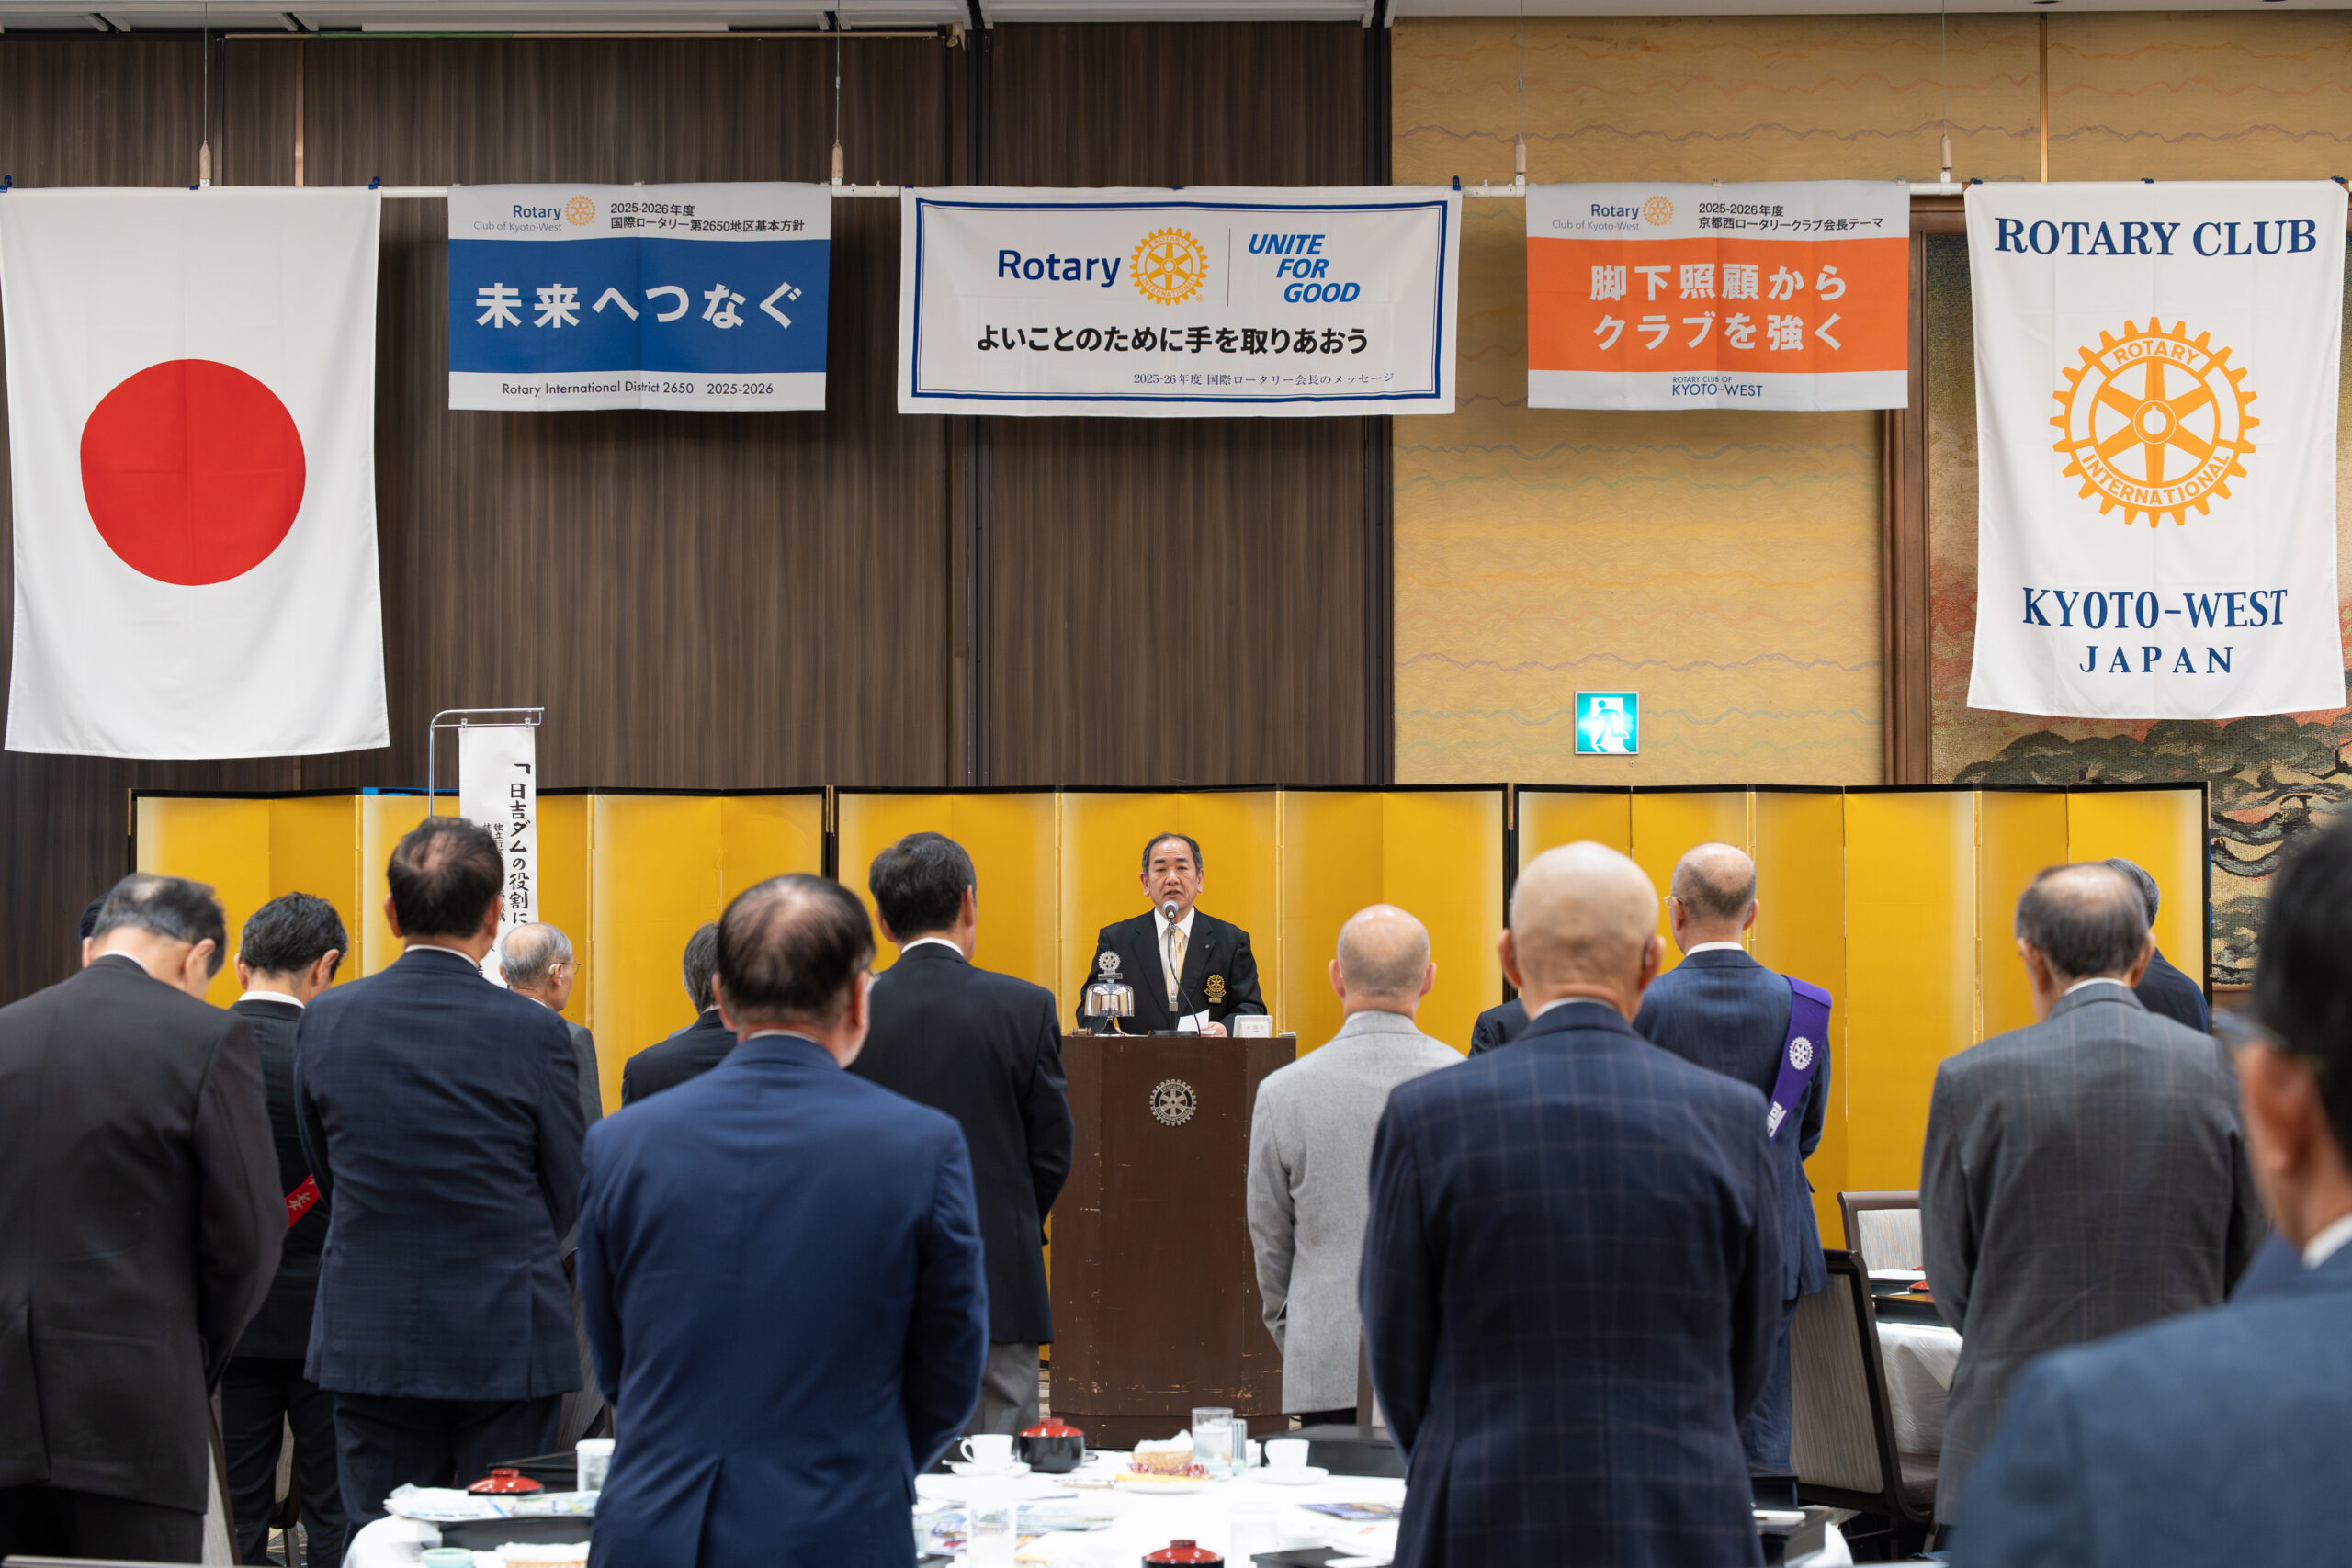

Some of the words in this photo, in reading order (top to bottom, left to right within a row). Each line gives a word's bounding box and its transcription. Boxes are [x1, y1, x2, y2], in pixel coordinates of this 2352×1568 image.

[513, 205, 561, 220] Rotary
[610, 202, 695, 217] 2025-2026年度
[1590, 203, 1640, 220] Rotary
[1698, 202, 1784, 217] 2025-2026年度
[473, 220, 495, 231] Club
[497, 221, 506, 231] of
[509, 222, 561, 232] Kyoto-West
[611, 216, 805, 232] 国際ロータリー第2650地区基本方針
[1552, 220, 1573, 230] Club
[1575, 220, 1585, 230] of
[1588, 220, 1640, 231] Kyoto-West
[1698, 217, 1883, 231] 京都西ロータリークラブ会長テーマ
[1153, 234, 1185, 244] ROTARY
[1248, 233, 1326, 255] UNITE
[1994, 217, 2181, 255] ROTARY
[2192, 219, 2317, 257] CLUB
[998, 250, 1121, 288] Rotary
[1275, 258, 1329, 278] FOR
[1142, 277, 1194, 297] INTERNATIONAL
[1589, 263, 1847, 301] 脚下照顧から
[1283, 282, 1361, 303] GOOD
[475, 282, 802, 329] 未来へつなぐ
[977, 324, 1369, 355] よいことのために手を取りあおう
[1593, 310, 1841, 352] クラブを強く
[2112, 340, 2200, 366] ROTARY
[1133, 373, 1203, 386] 2025-26年度
[1206, 371, 1395, 386] 国際ロータリー会長のメッセージ
[1702, 375, 1720, 383] CLUB
[503, 383, 541, 398] Rotary
[546, 381, 620, 395] International
[625, 380, 660, 394] District
[662, 382, 694, 395] 2650
[707, 382, 774, 395] 2025-2026
[1672, 383, 1763, 397] KYOTO-WEST
[2081, 452, 2231, 505] INTERNATIONAL
[2022, 587, 2288, 629] KYOTO-WEST
[2079, 645, 2233, 674] JAPAN
